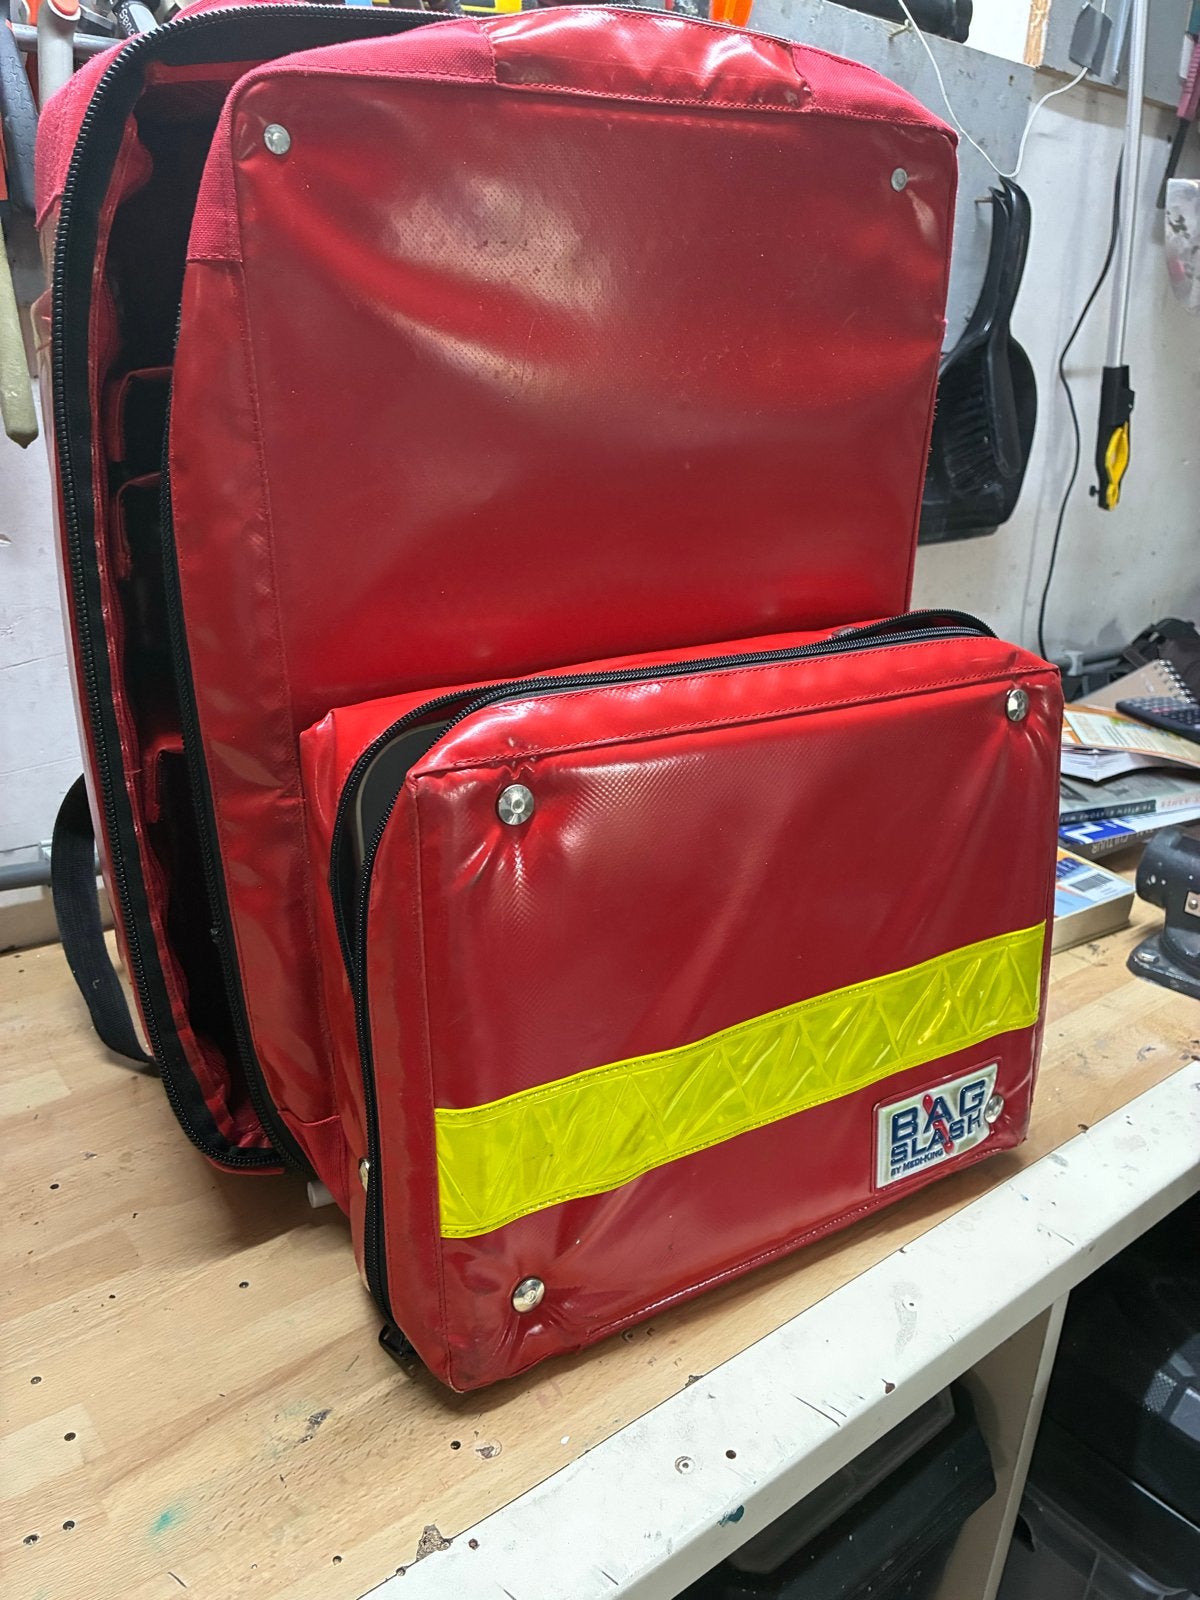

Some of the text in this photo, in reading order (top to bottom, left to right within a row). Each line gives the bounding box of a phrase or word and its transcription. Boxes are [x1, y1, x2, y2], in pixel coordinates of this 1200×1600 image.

[890, 1107, 982, 1166] SLASH
[891, 1080, 986, 1145] BAG
[890, 1165, 902, 1177] BY
